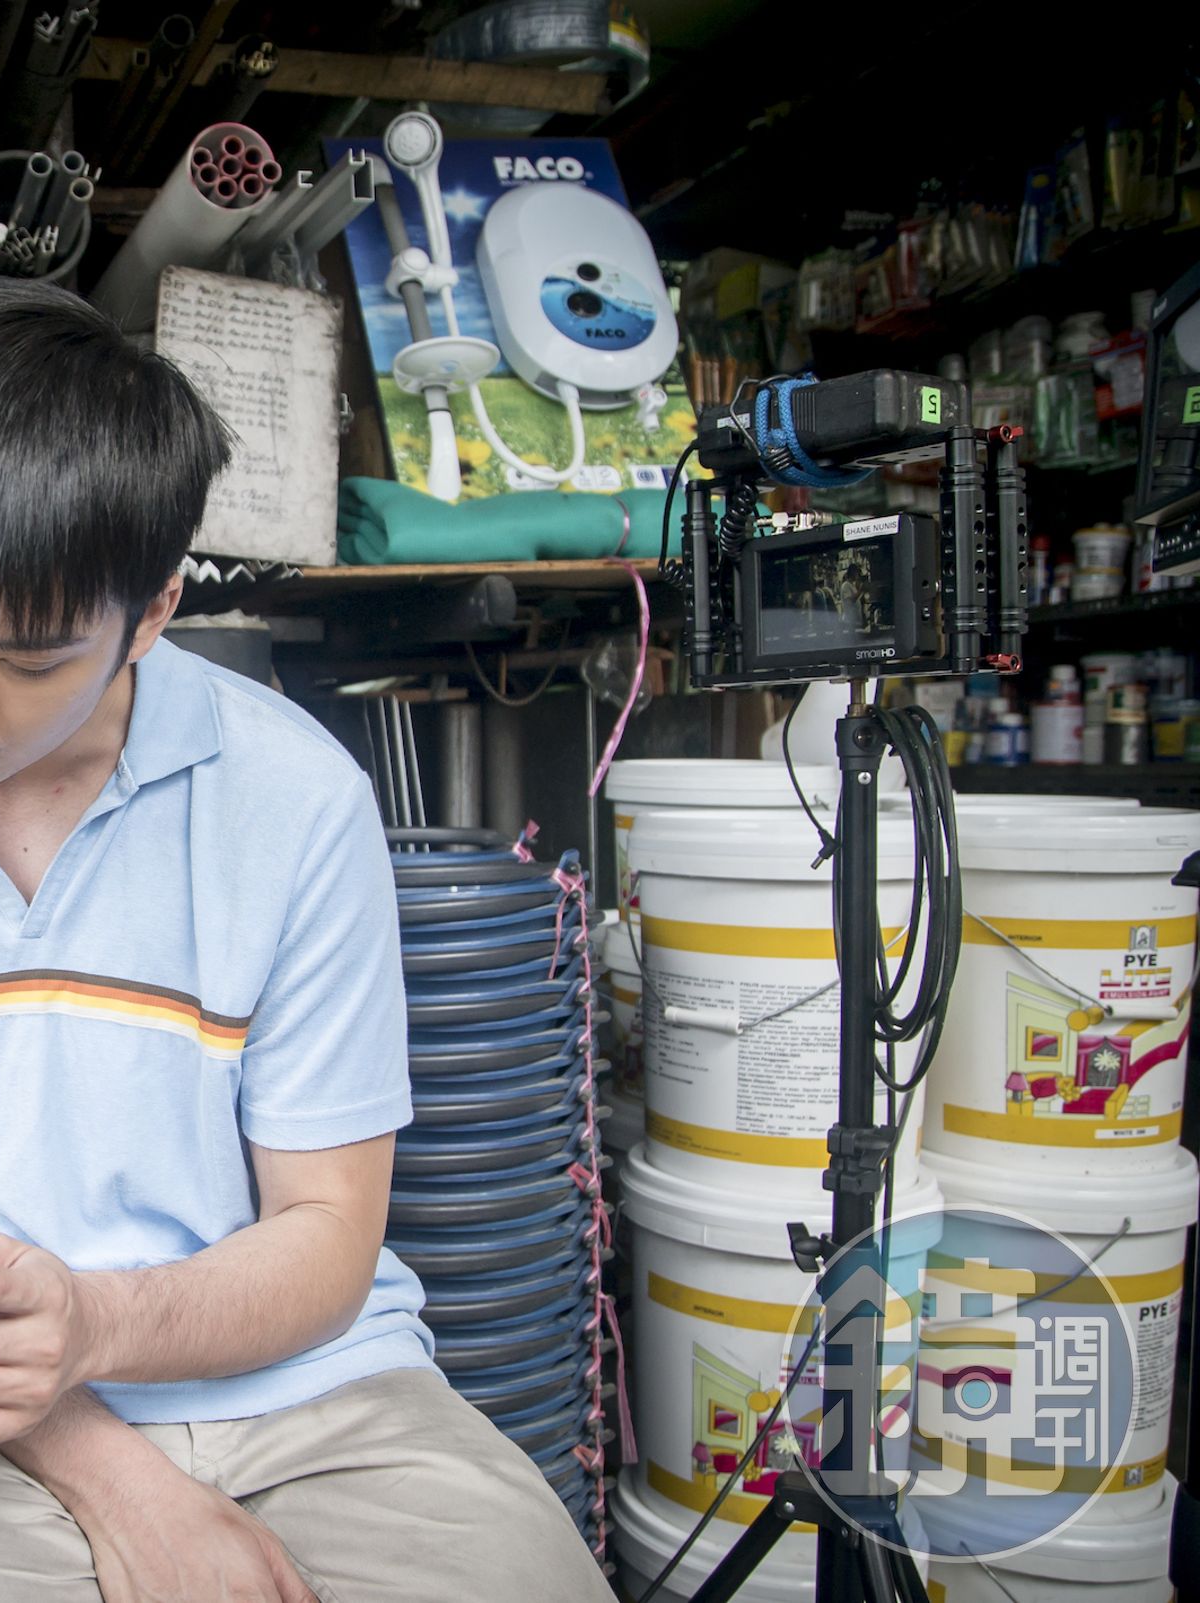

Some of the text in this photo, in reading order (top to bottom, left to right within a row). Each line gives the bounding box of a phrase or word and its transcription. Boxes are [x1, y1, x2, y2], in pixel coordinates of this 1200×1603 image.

[585, 328, 626, 340] FACO
[845, 521, 897, 536] SHANE NUNIS
[1124, 953, 1158, 967] PYE
[1139, 1302, 1168, 1322] PYE
